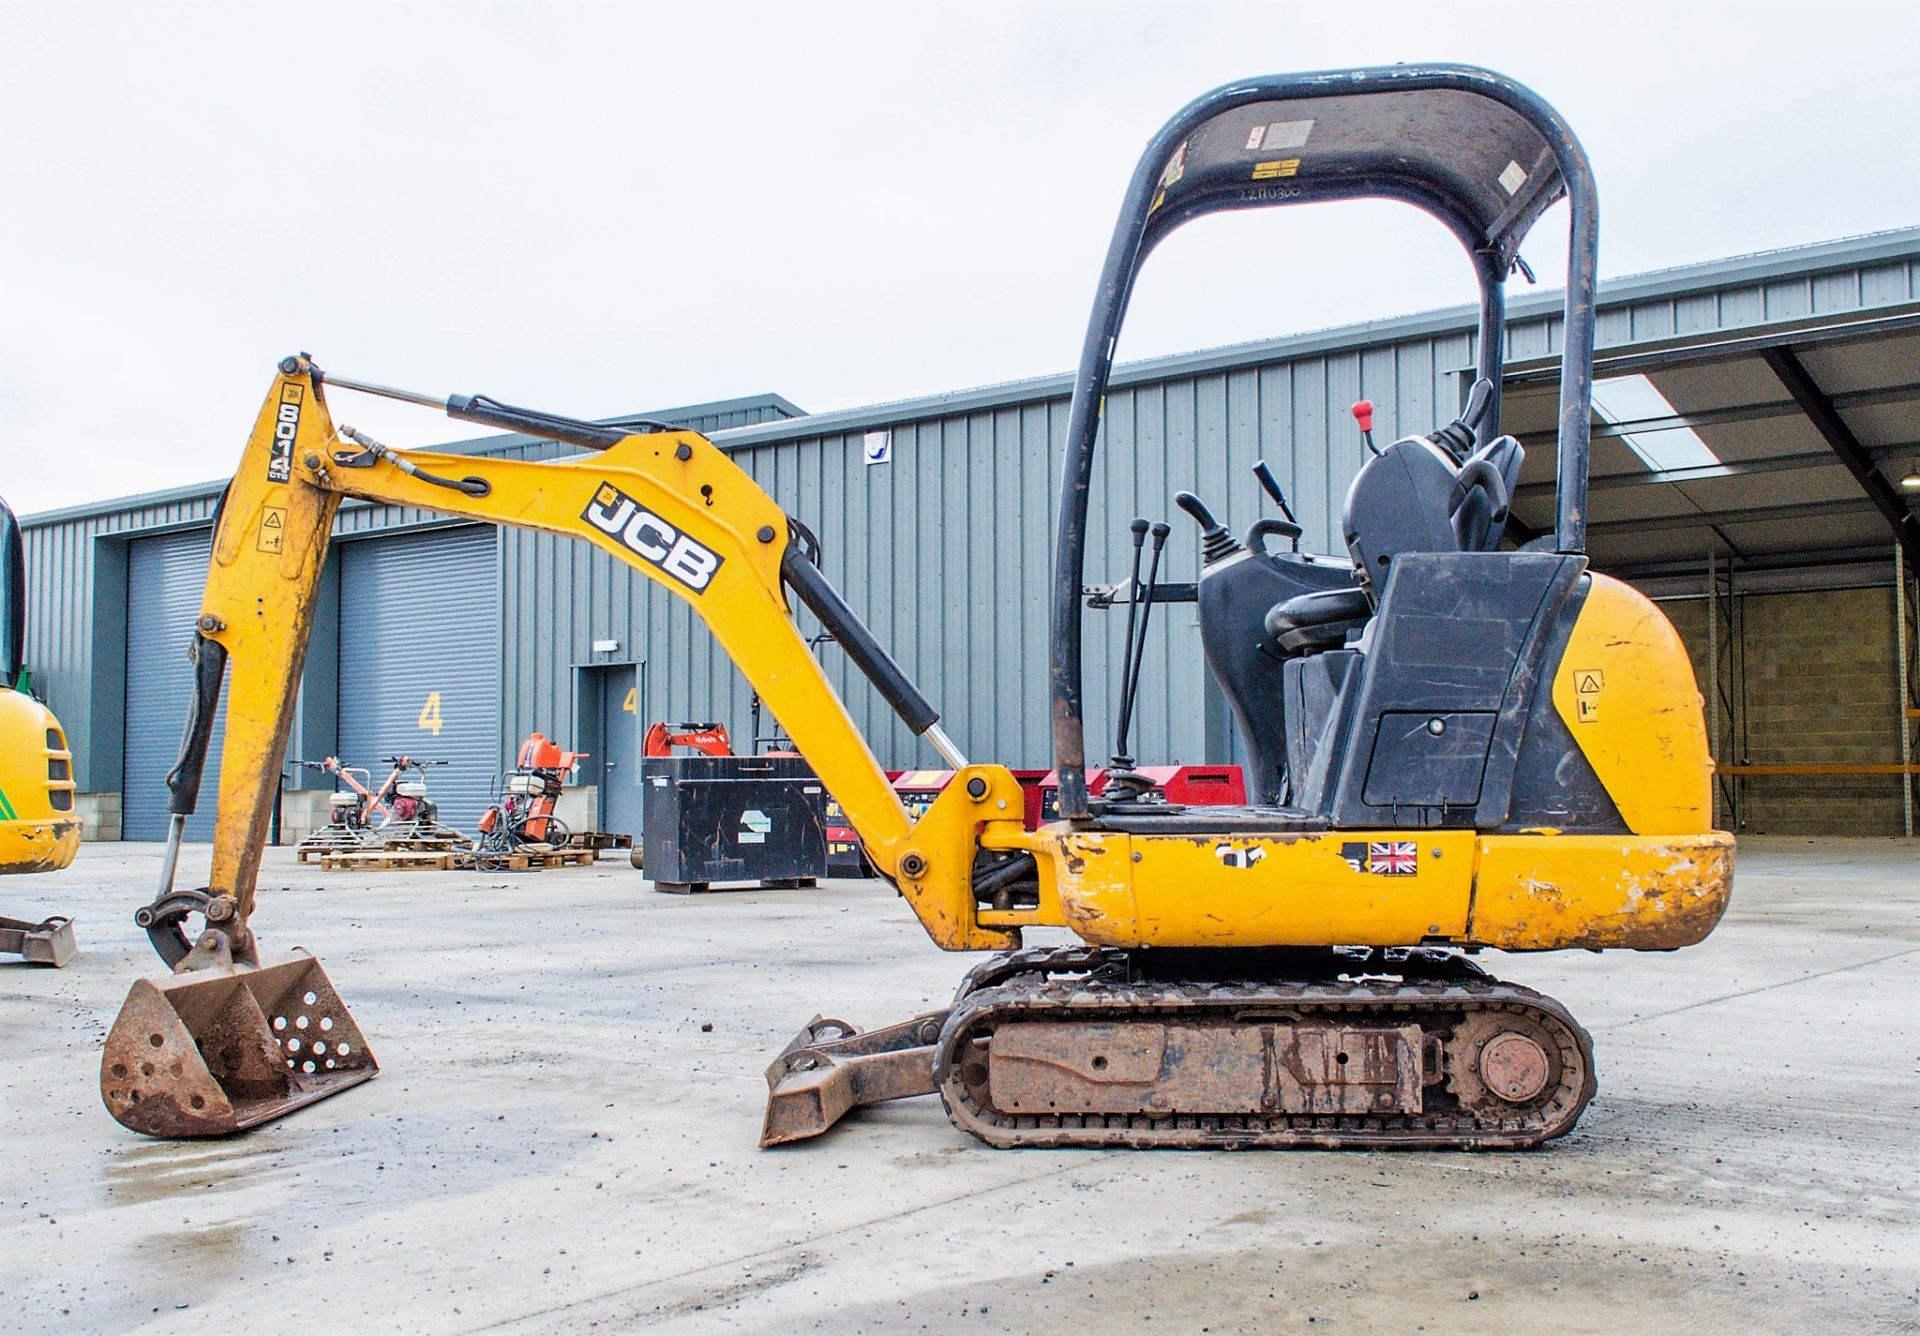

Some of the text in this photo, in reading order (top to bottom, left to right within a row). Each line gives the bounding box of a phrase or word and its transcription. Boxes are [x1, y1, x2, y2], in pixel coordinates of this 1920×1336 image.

[270, 403, 300, 474] 8014
[587, 498, 718, 590] JCB
[418, 691, 443, 737] 4
